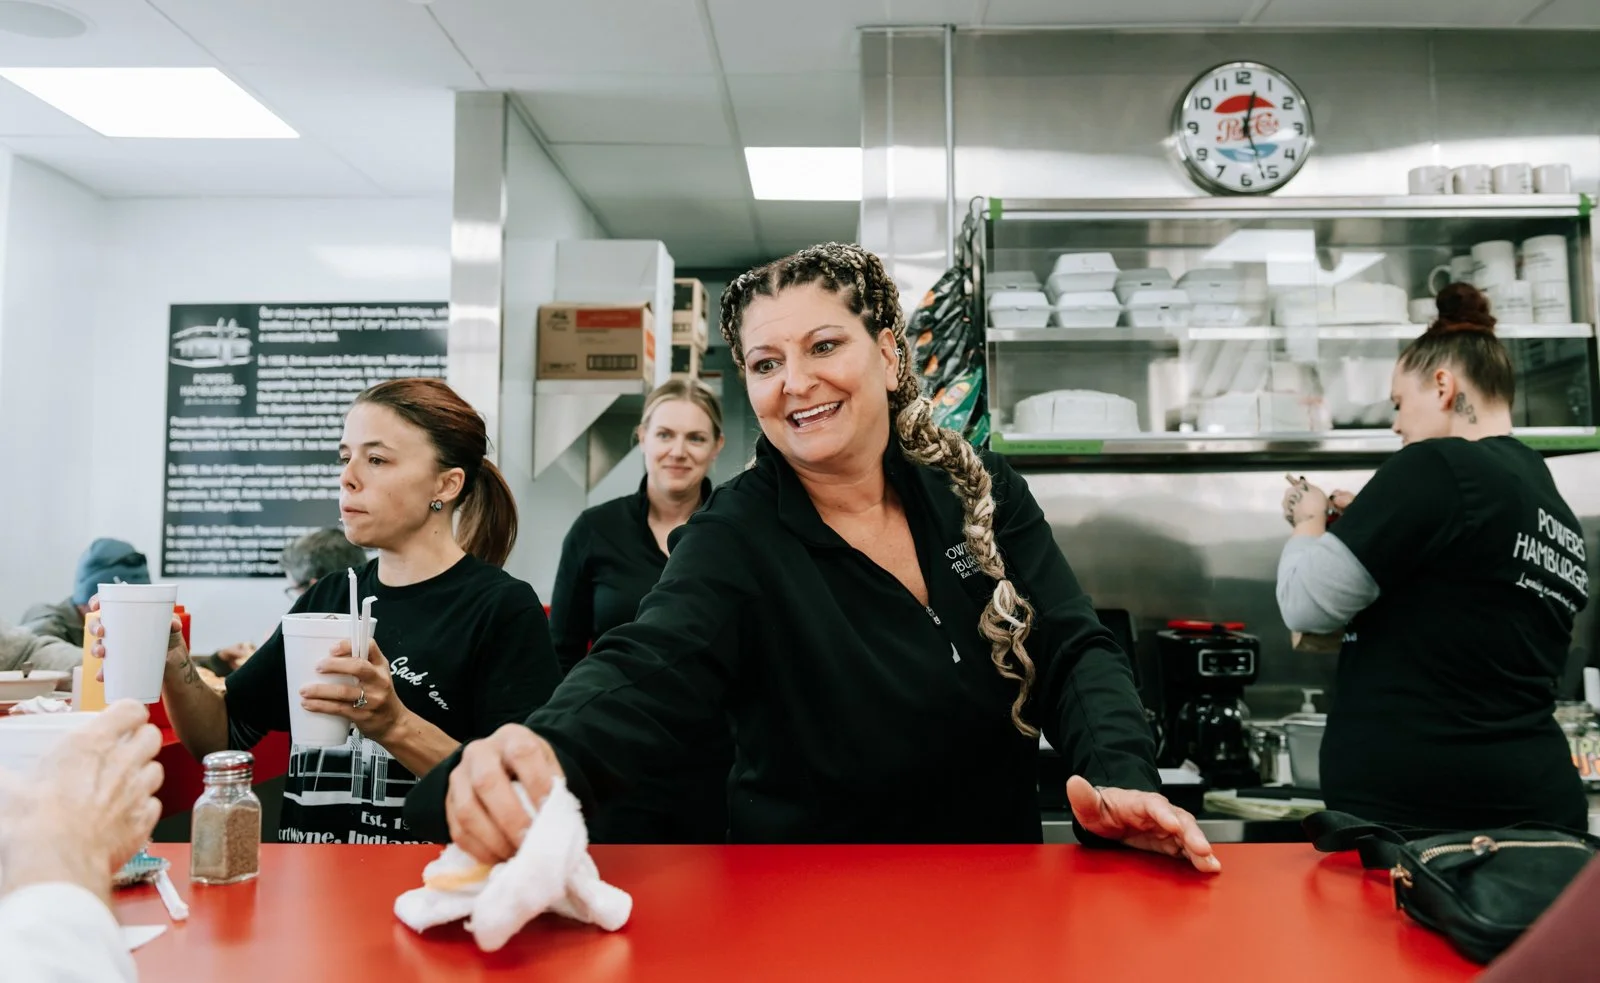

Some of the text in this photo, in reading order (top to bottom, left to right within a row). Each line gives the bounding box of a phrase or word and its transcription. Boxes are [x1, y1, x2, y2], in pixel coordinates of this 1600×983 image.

[1216, 78, 1227, 91] 11
[1236, 72, 1252, 84] 12
[1268, 78, 1272, 91] 1
[1195, 97, 1212, 110] 10
[1282, 97, 1294, 110] 2
[1187, 122, 1199, 134] 9
[1293, 122, 1304, 135] 3
[1196, 148, 1208, 160] 8
[1284, 148, 1294, 160] 4
[1216, 166, 1226, 178] 7
[1266, 166, 1279, 179] 5
[1241, 174, 1252, 186] 6
[1538, 507, 1586, 562] POWERS
[390, 656, 428, 686] Sack
[428, 684, 450, 710] 'em
[361, 811, 387, 828] Est.
